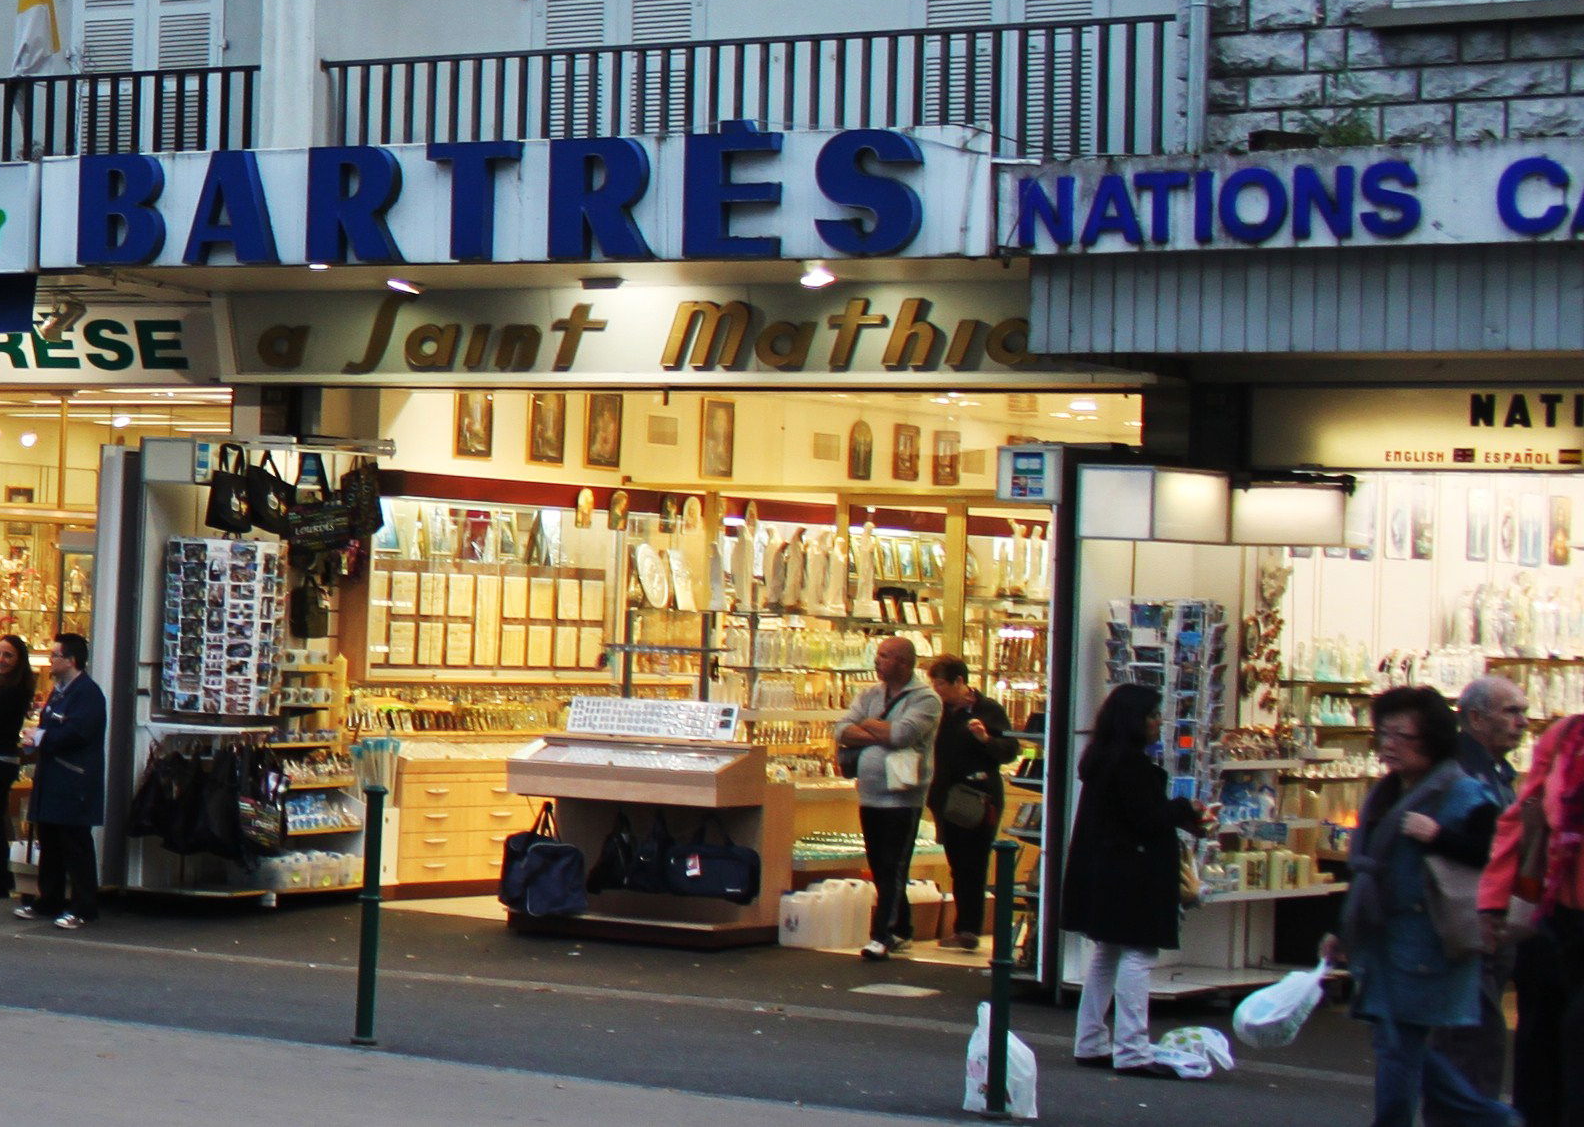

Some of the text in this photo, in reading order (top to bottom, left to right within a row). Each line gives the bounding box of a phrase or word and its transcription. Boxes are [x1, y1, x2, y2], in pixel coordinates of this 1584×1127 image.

[76, 119, 924, 267] BARTRÈS
[1018, 157, 1584, 249] NATIONS C
[343, 295, 605, 375] Saint
[1385, 449, 1551, 464] ENGLISH ESPAÑOL
